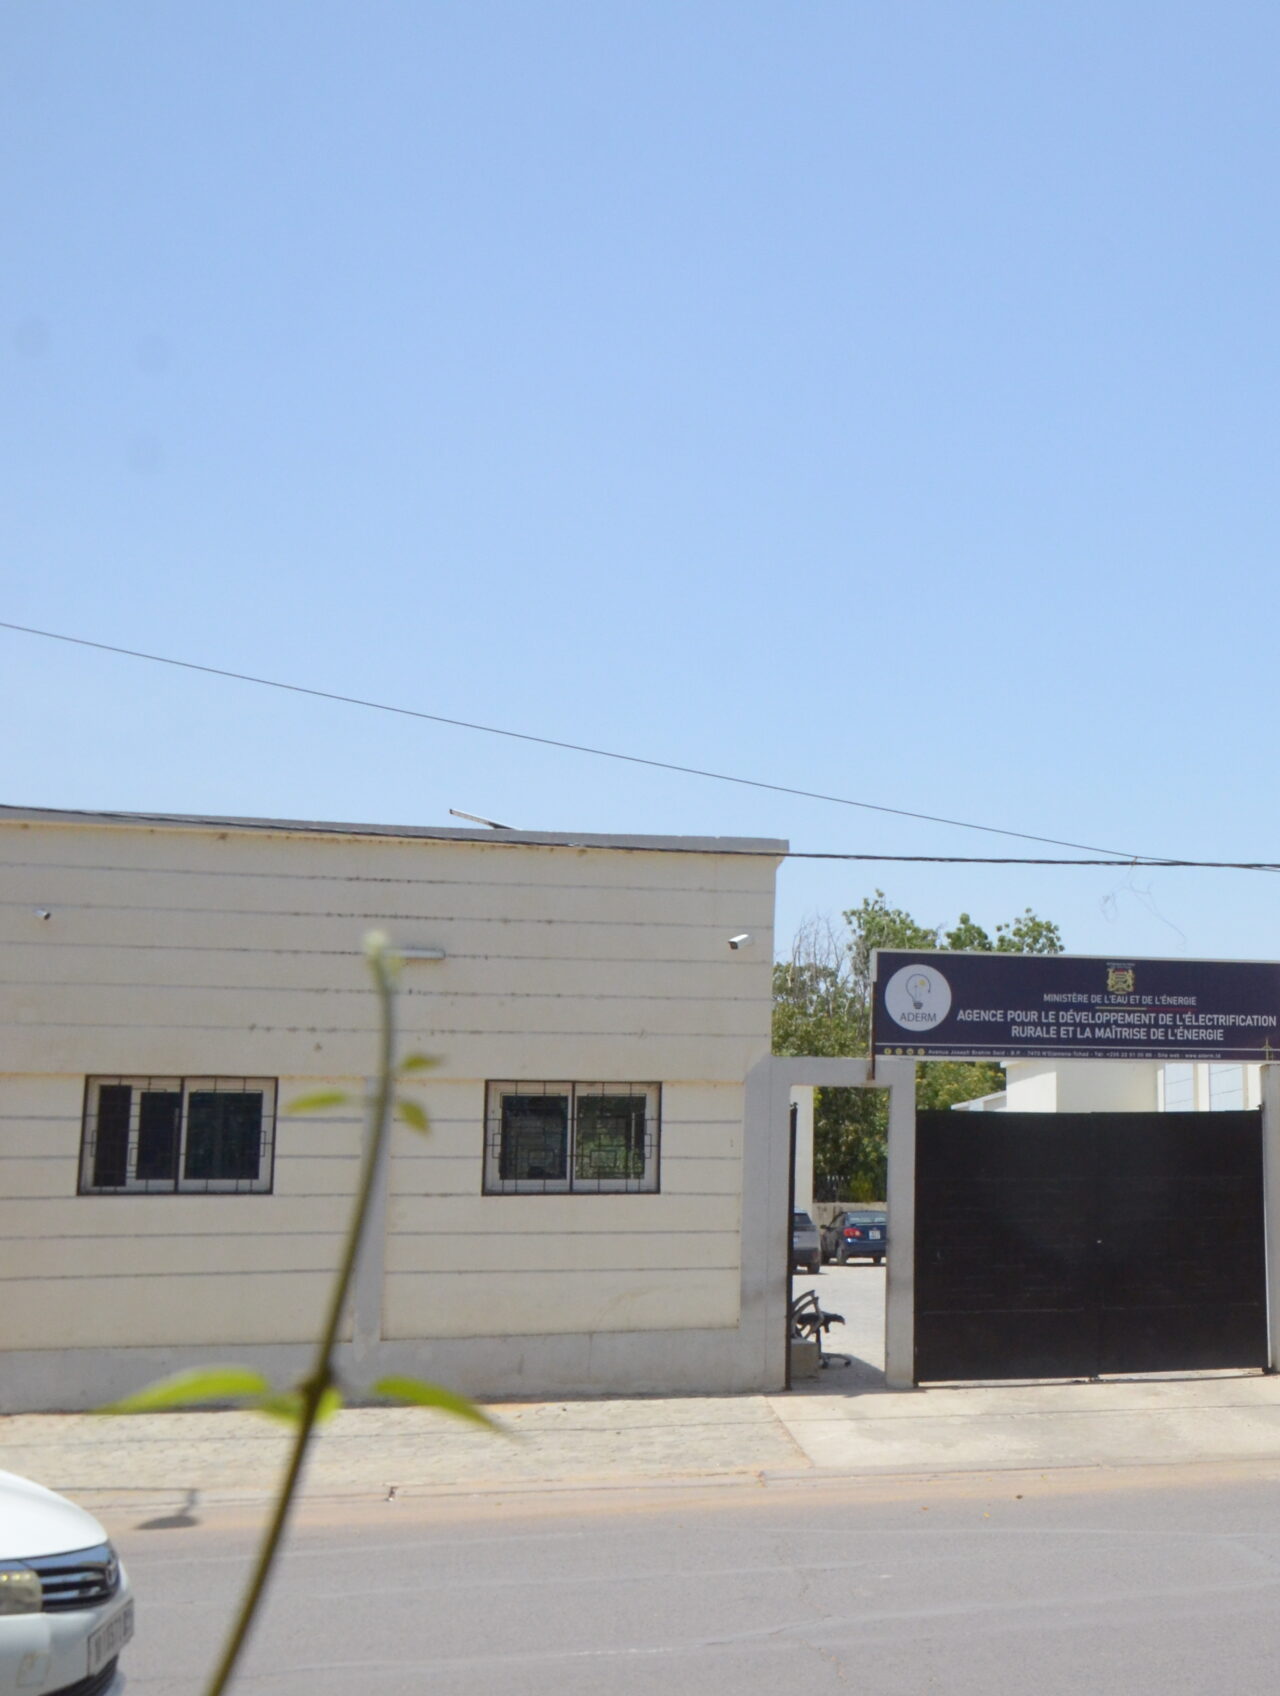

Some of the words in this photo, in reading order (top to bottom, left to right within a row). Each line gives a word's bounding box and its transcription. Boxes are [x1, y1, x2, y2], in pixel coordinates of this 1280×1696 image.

[1043, 993, 1088, 1003] MINISTÈRE
[1091, 995, 1102, 1003] DE
[1104, 995, 1127, 1004] L'EAU
[1130, 995, 1140, 1004] ET
[1142, 996, 1152, 1004] DE
[1155, 995, 1197, 1006] L'ÉNERGIE
[900, 1012, 936, 1022] ADERM
[957, 1010, 1004, 1021] AGENCE
[1007, 1011, 1038, 1022] POUR
[1041, 1011, 1056, 1023] LE
[1059, 1009, 1156, 1025] DÉVELOPPEMENT
[1159, 1013, 1173, 1025] DE
[1176, 1011, 1277, 1027] L'ÉLECTRIFICATION
[1011, 1026, 1057, 1038] RURALE
[1060, 1027, 1074, 1038] ET
[1077, 1027, 1092, 1038] LA
[1095, 1025, 1147, 1039] MAÎTRISE
[1150, 1028, 1165, 1040] DE
[1168, 1026, 1224, 1041] L'ÉNERGIE
